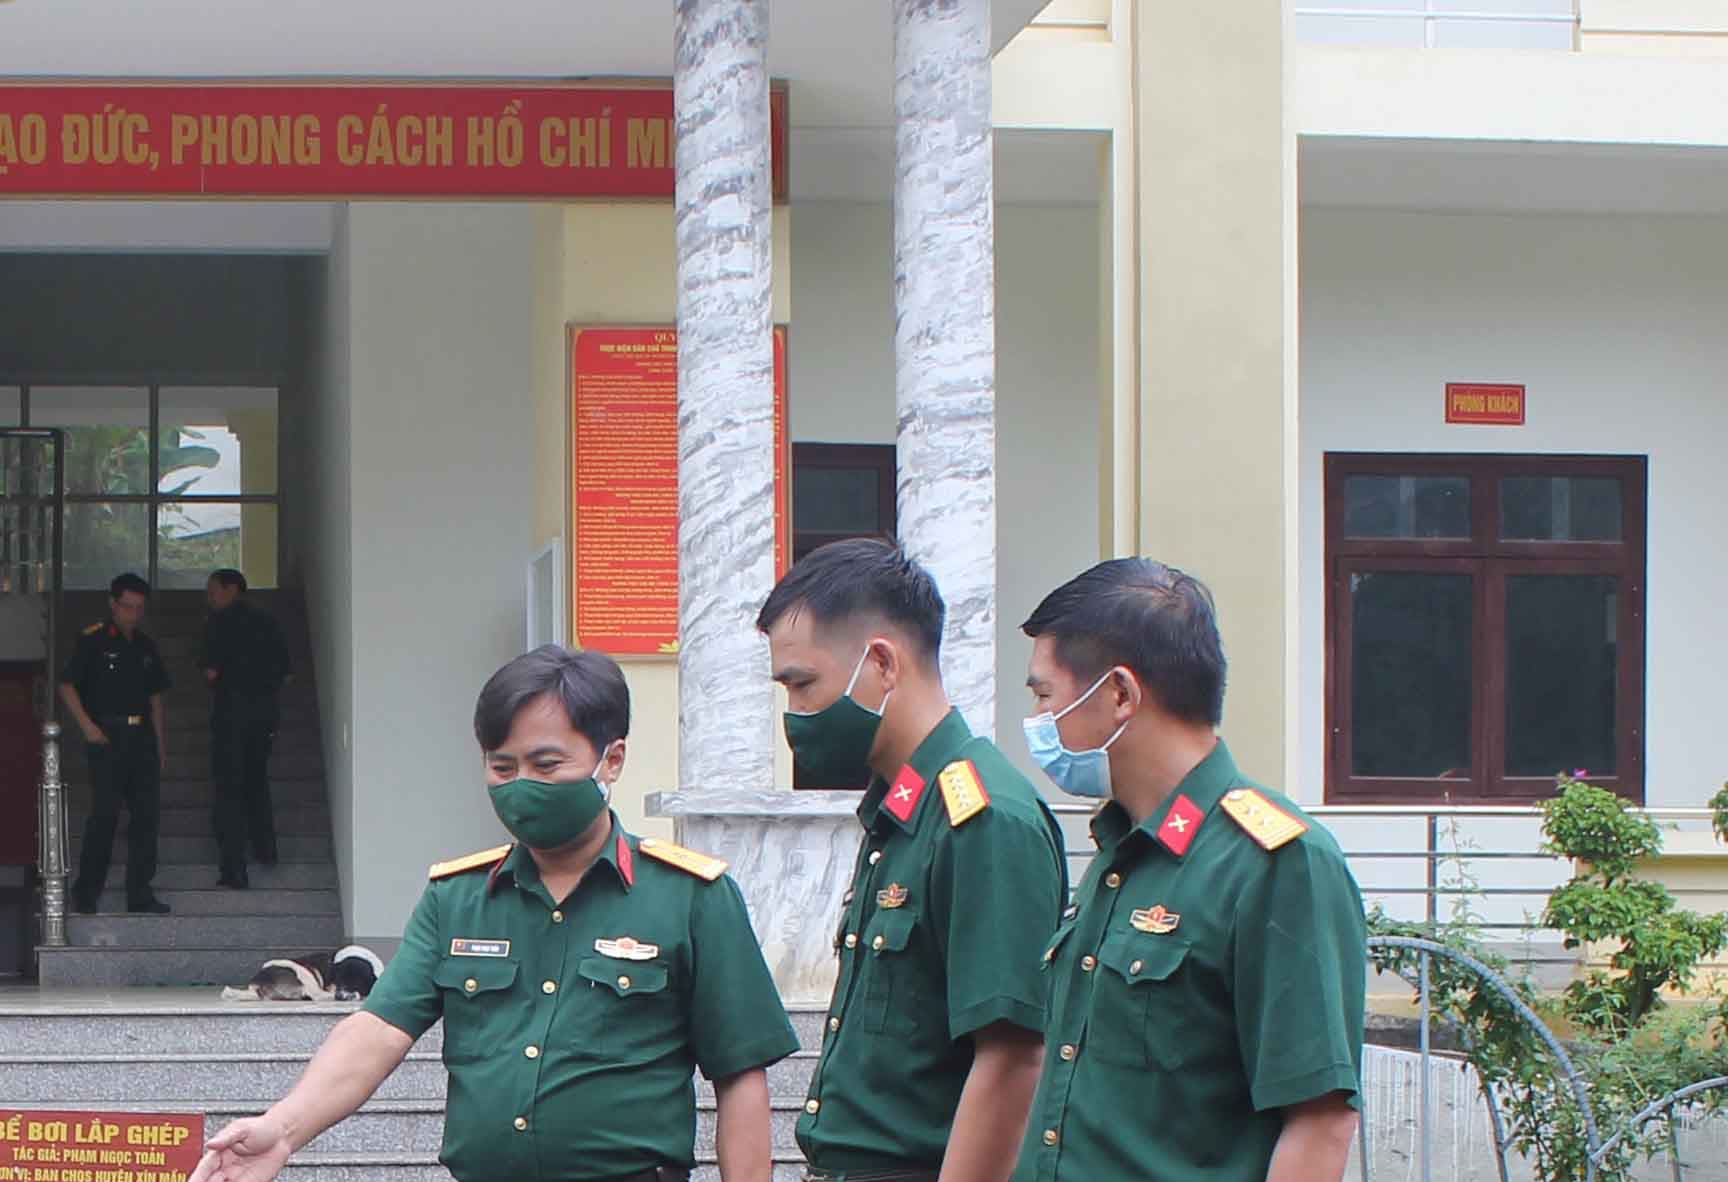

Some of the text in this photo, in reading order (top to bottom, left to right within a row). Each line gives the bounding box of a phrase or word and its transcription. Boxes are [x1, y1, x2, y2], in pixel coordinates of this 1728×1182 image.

[62, 103, 160, 167] ĐỨC,
[172, 114, 321, 165] PHONG
[338, 103, 453, 167] CÁCH
[467, 100, 523, 167] HỒ
[540, 107, 610, 167] CHÍ
[28, 1120, 68, 1142] BƠI
[75, 1118, 120, 1144] LẮP
[127, 1122, 190, 1147] GHÉP
[12, 1146, 35, 1162] TÁC
[37, 1143, 61, 1163] GIẢ:
[63, 1149, 98, 1167] PHẠM
[100, 1149, 133, 1168] NGỌC
[34, 1168, 59, 1182] BAN
